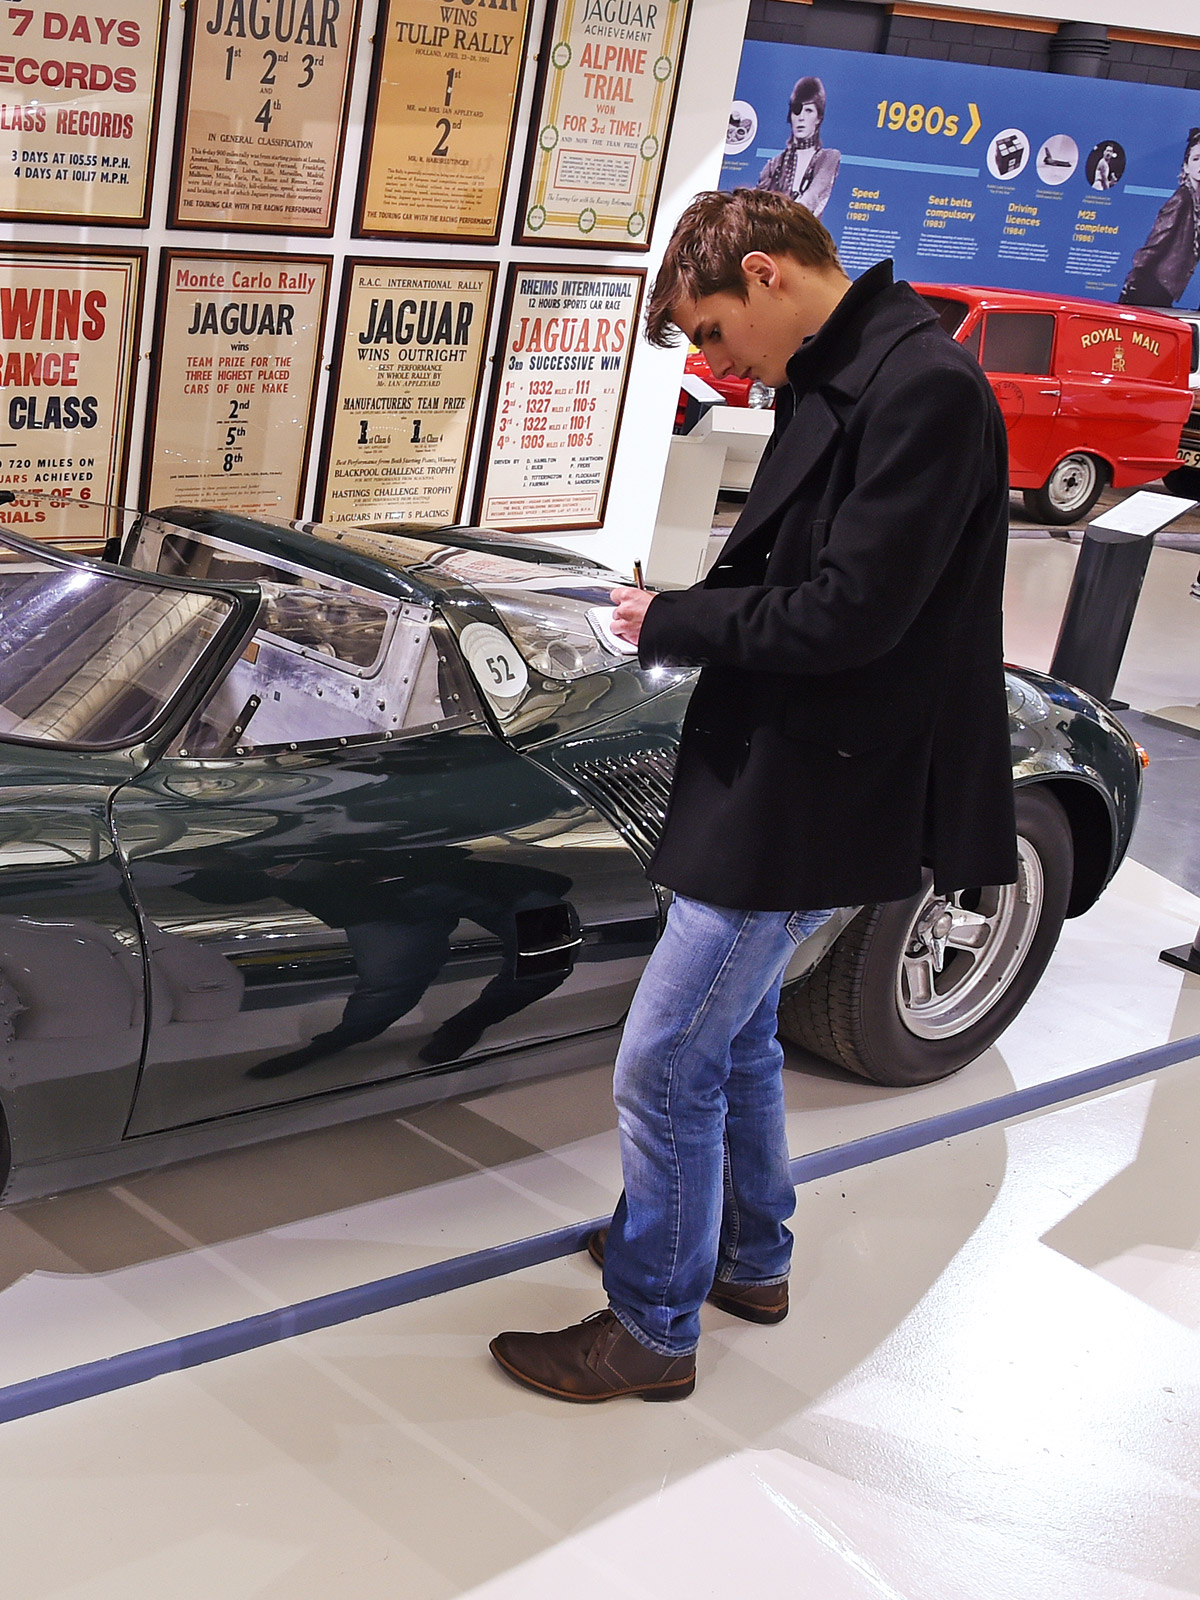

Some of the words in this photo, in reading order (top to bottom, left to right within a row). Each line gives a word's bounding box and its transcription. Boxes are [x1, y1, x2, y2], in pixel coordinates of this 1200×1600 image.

[207, 0, 339, 48] JAGUAR
[440, 6, 478, 27] WINS
[581, 0, 657, 30] JAGUAR
[8, 8, 34, 36] 7
[43, 12, 141, 47] DAYS
[585, 25, 652, 43] ACHIEVEMENT
[396, 22, 449, 47] TULIP
[453, 29, 514, 56] RALLY
[580, 43, 647, 74] ALPINE
[584, 73, 634, 103] TRIAL
[596, 104, 615, 114] WON
[877, 100, 960, 136] 1980s
[56, 109, 133, 139] RECORDS
[563, 115, 587, 131] FOR
[609, 119, 641, 137] TIME!
[208, 133, 216, 141] IN
[220, 135, 253, 144] GENERAL
[258, 138, 313, 149] CLASSIFICATION
[852, 188, 880, 199] Speed
[928, 195, 948, 205] Seat
[950, 198, 973, 208] belts
[849, 201, 886, 212] cameras
[926, 208, 976, 222] compulsory
[1008, 203, 1038, 216] Driving
[1078, 210, 1096, 220] M25
[1075, 223, 1119, 234] completed
[176, 269, 225, 287] Monte
[232, 271, 271, 289] Carlo
[278, 272, 316, 294] Rally
[359, 278, 382, 287] R.A.C.
[388, 278, 452, 289] INTERNATIONAL
[458, 281, 483, 290] RALLY
[520, 280, 558, 295] RHEIMS
[561, 281, 631, 297] INTERNATIONAL
[0, 287, 107, 341] WINS
[188, 302, 294, 335] JAGUAR
[359, 299, 474, 345] JAGUAR
[512, 317, 626, 352] JAGUARS
[1080, 328, 1122, 348] ROYAL
[1132, 332, 1160, 356] MAIL
[230, 341, 249, 351] wins
[358, 349, 390, 361] WINS
[398, 350, 467, 362] OUTRIGHT
[529, 356, 595, 370] SUCCESSIVE
[601, 356, 621, 370] WIN
[529, 381, 553, 395] 1332
[575, 380, 590, 394] 111
[8, 396, 98, 429] CLASS
[332, 489, 371, 498] HASTINGS
[374, 488, 418, 496] CHALLENGE
[486, 655, 516, 685] 52
